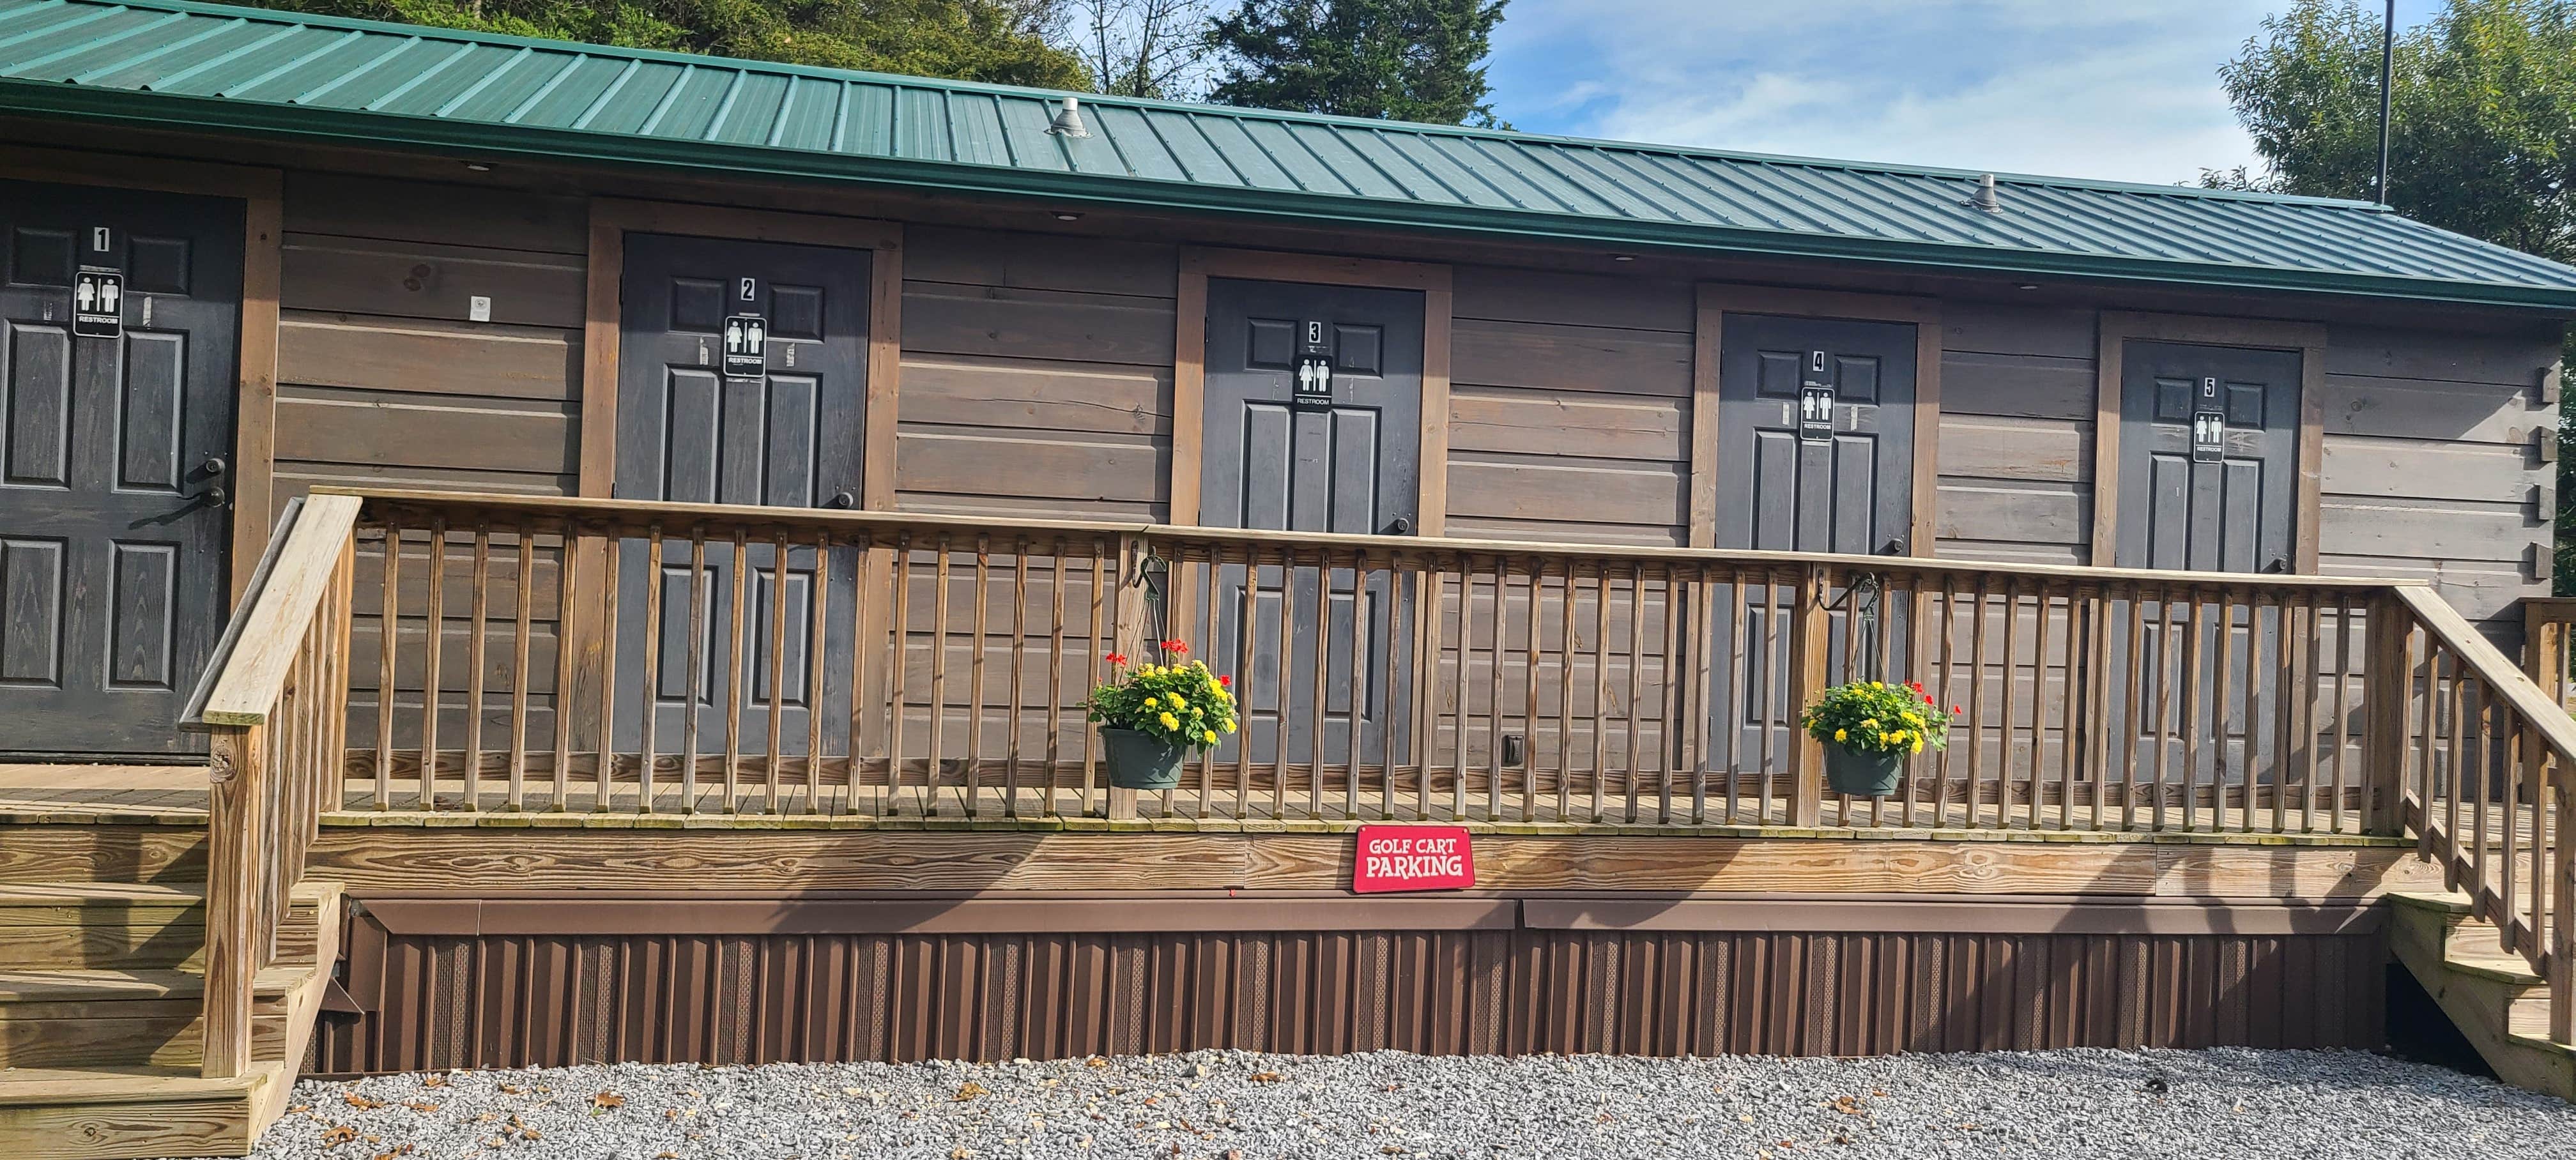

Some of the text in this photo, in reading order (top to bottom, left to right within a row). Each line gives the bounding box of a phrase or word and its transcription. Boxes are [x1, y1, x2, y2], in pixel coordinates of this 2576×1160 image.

[98, 228, 107, 250] 1
[742, 279, 753, 299] 2
[78, 316, 118, 324] RESTROOM
[1310, 323, 1319, 342] 3
[1814, 353, 1823, 370] 4
[2205, 379, 2213, 395] 5
[1368, 838, 1457, 855] GOLF CART
[1366, 855, 1464, 880] PARKING
